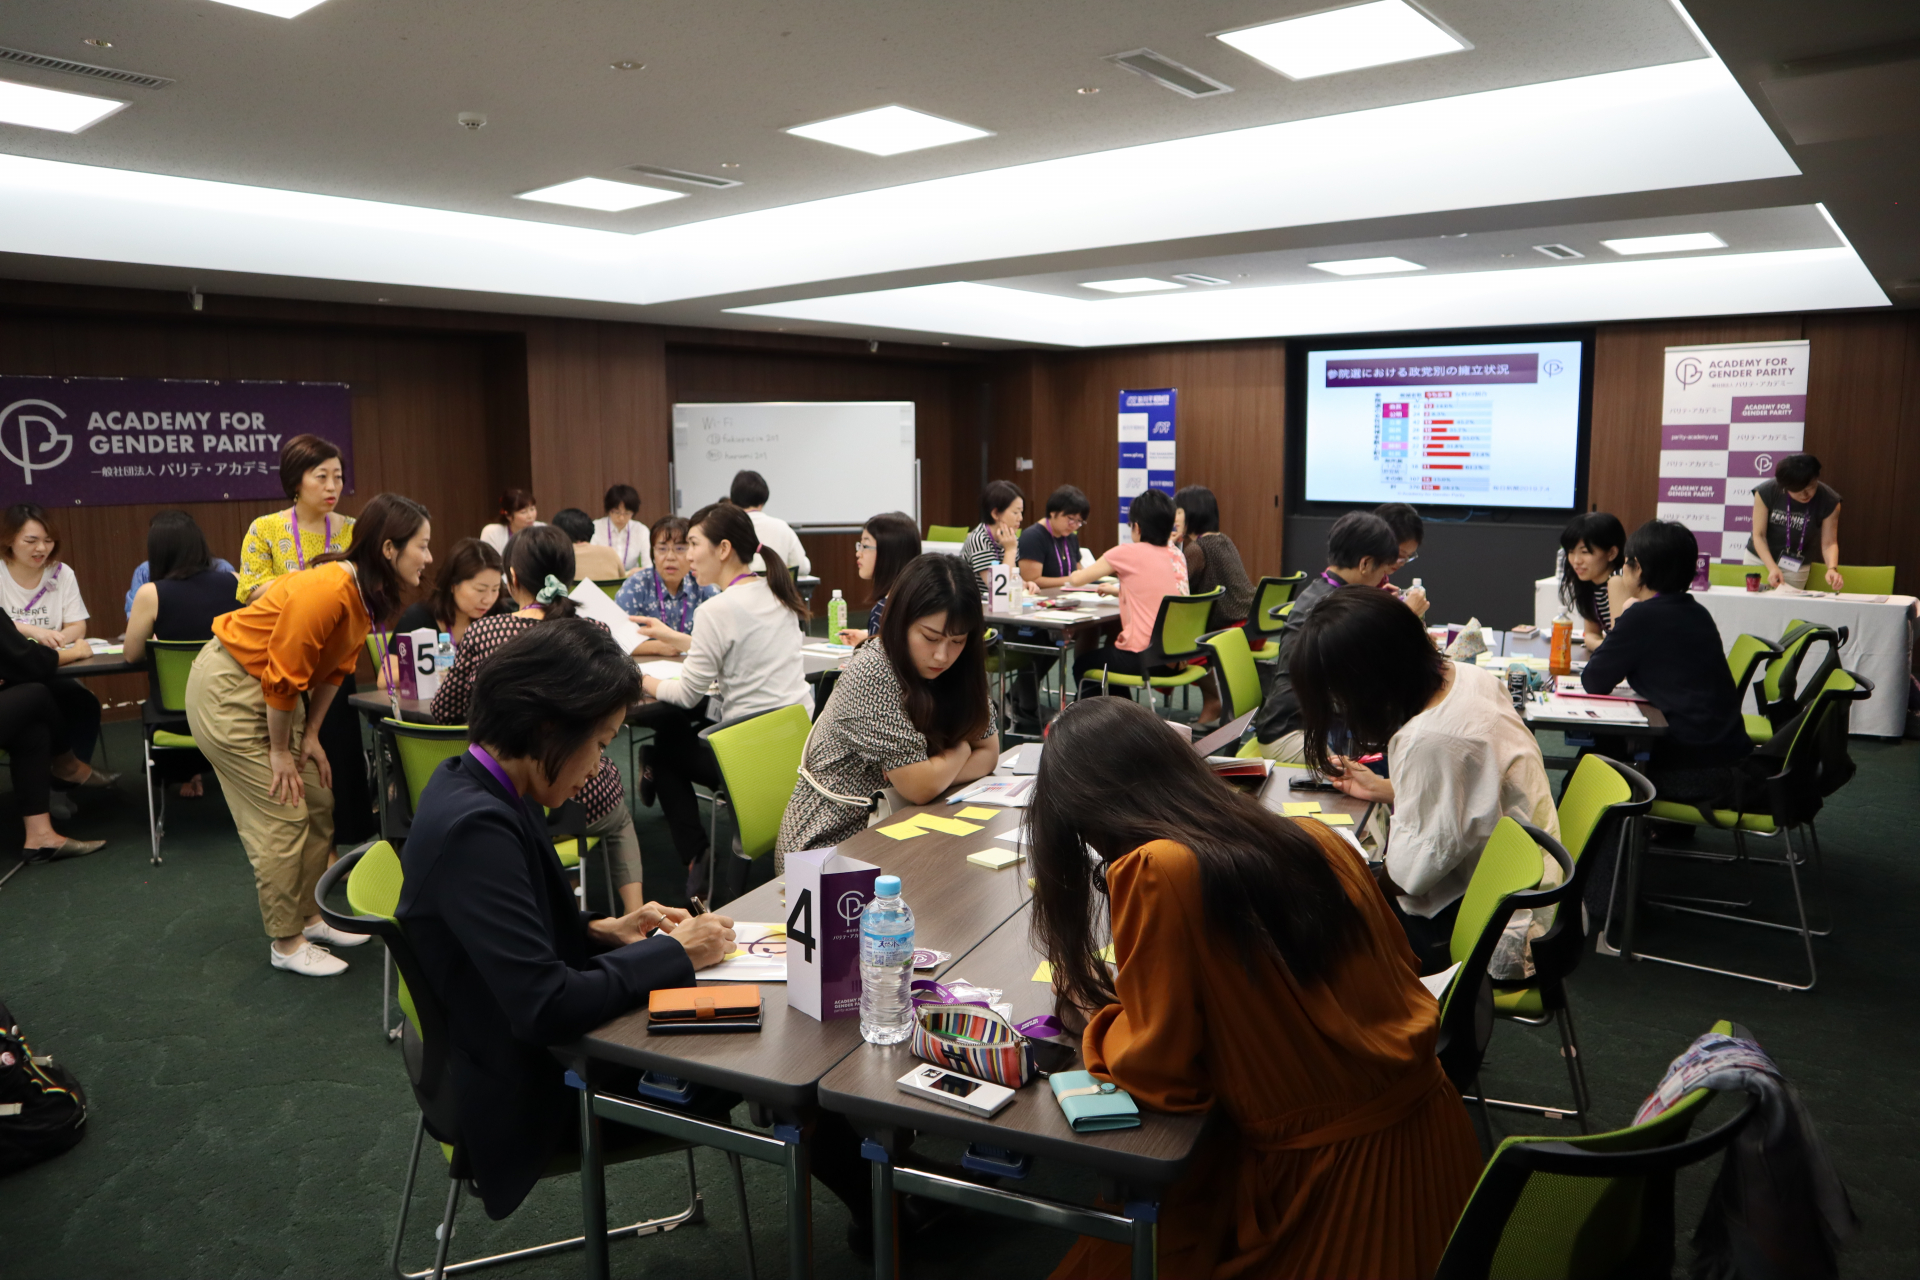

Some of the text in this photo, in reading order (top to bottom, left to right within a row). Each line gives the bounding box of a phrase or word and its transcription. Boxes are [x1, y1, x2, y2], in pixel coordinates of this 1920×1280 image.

[1709, 357, 1788, 368] ACADEMY FOR
[1708, 367, 1795, 379] GENDER PARITY
[87, 411, 266, 431] ACADEMY FOR
[89, 434, 282, 454] GENDER PARITY
[91, 461, 281, 478] 一般社団法人 パリテ・アカデミー
[994, 574, 1007, 596] 2
[417, 643, 435, 675] 5
[1512, 674, 1523, 708] BLACK
[786, 888, 816, 964] 4
